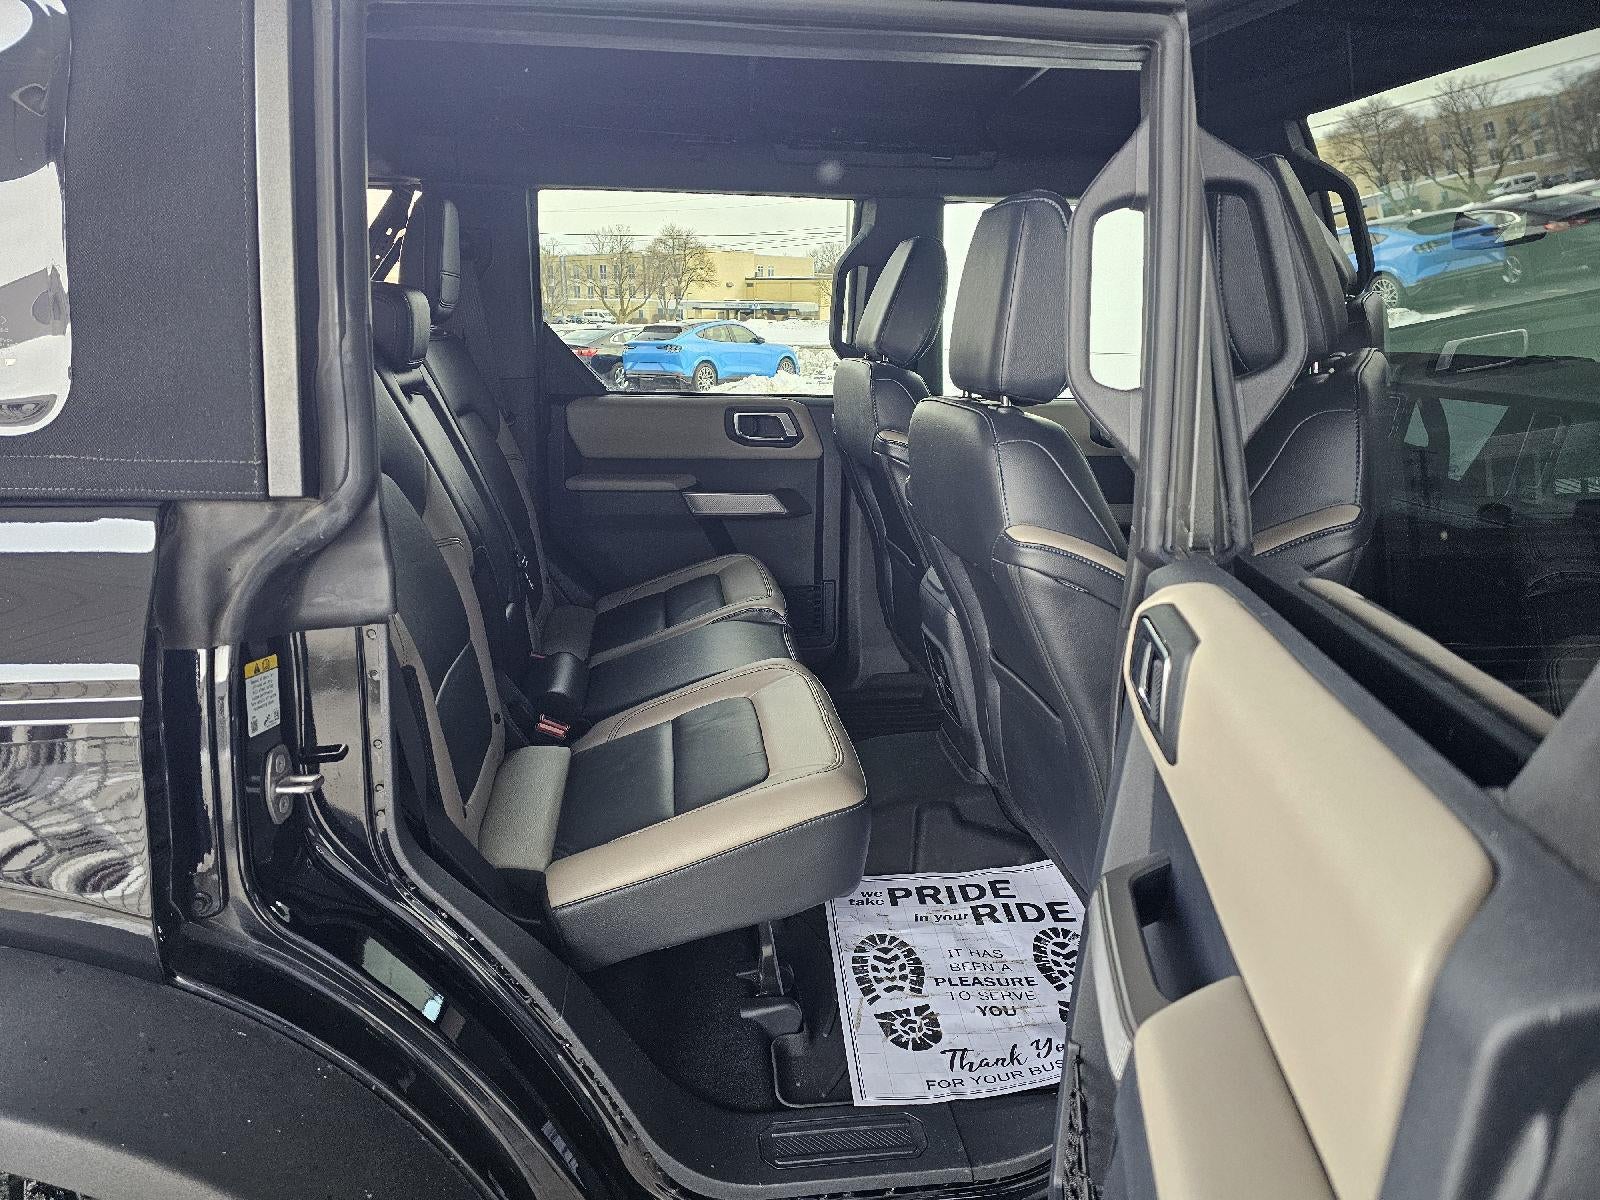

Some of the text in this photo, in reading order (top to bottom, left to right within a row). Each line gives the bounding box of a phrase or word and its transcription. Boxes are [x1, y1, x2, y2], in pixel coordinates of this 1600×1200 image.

[887, 879, 1016, 906] PRIDE
[848, 898, 884, 906] take
[914, 913, 968, 923] in your
[970, 902, 1077, 925] RIDE
[948, 948, 1004, 958] IT HAS
[950, 962, 1013, 972] BEEN A
[934, 976, 1038, 986] PLEASURE
[946, 990, 1036, 1000] TO SERVE
[976, 1006, 1016, 1016] YOU
[940, 1044, 1028, 1072] Thank
[926, 1060, 1063, 1090] FOR YOUR BUS
